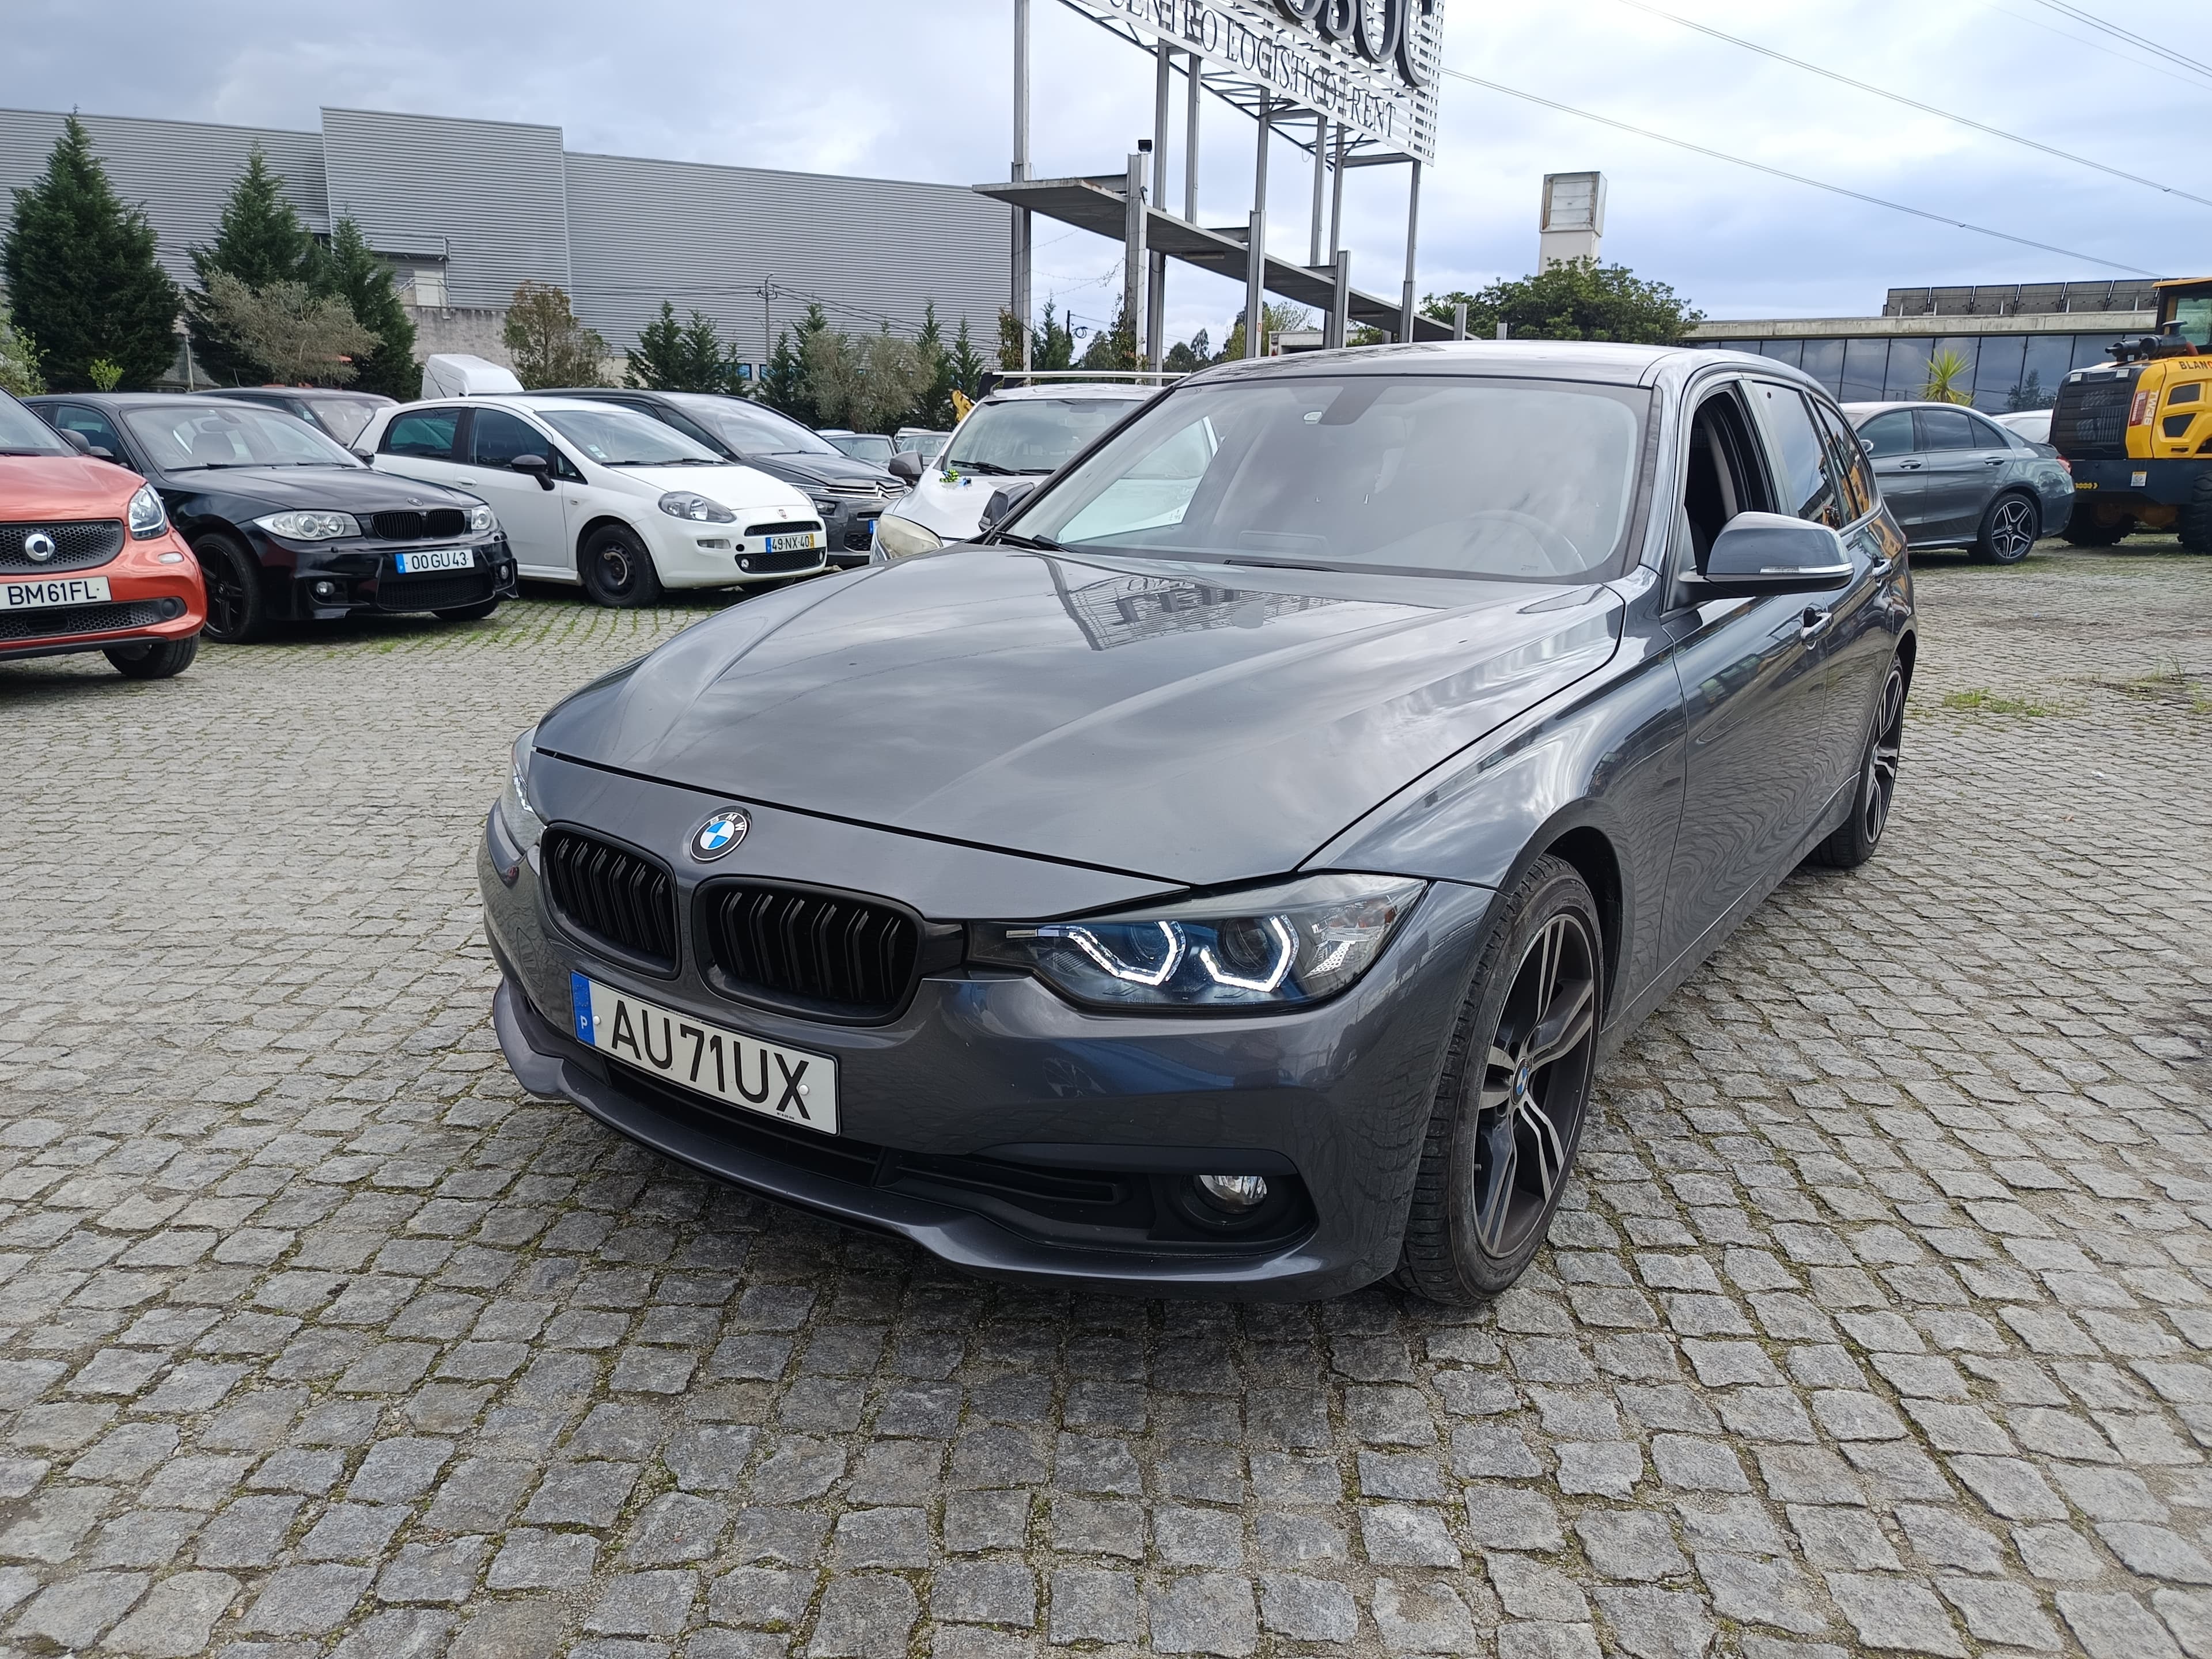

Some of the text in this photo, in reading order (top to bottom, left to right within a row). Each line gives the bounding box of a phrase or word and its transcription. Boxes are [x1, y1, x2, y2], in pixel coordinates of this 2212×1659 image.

[1109, 0, 1217, 52] NTRO
[1351, 86, 1396, 138] RENT
[7, 581, 97, 605] BM61FL
[710, 813, 745, 831] BMW
[580, 1015, 588, 1029] P
[611, 999, 811, 1120] AU71UX
